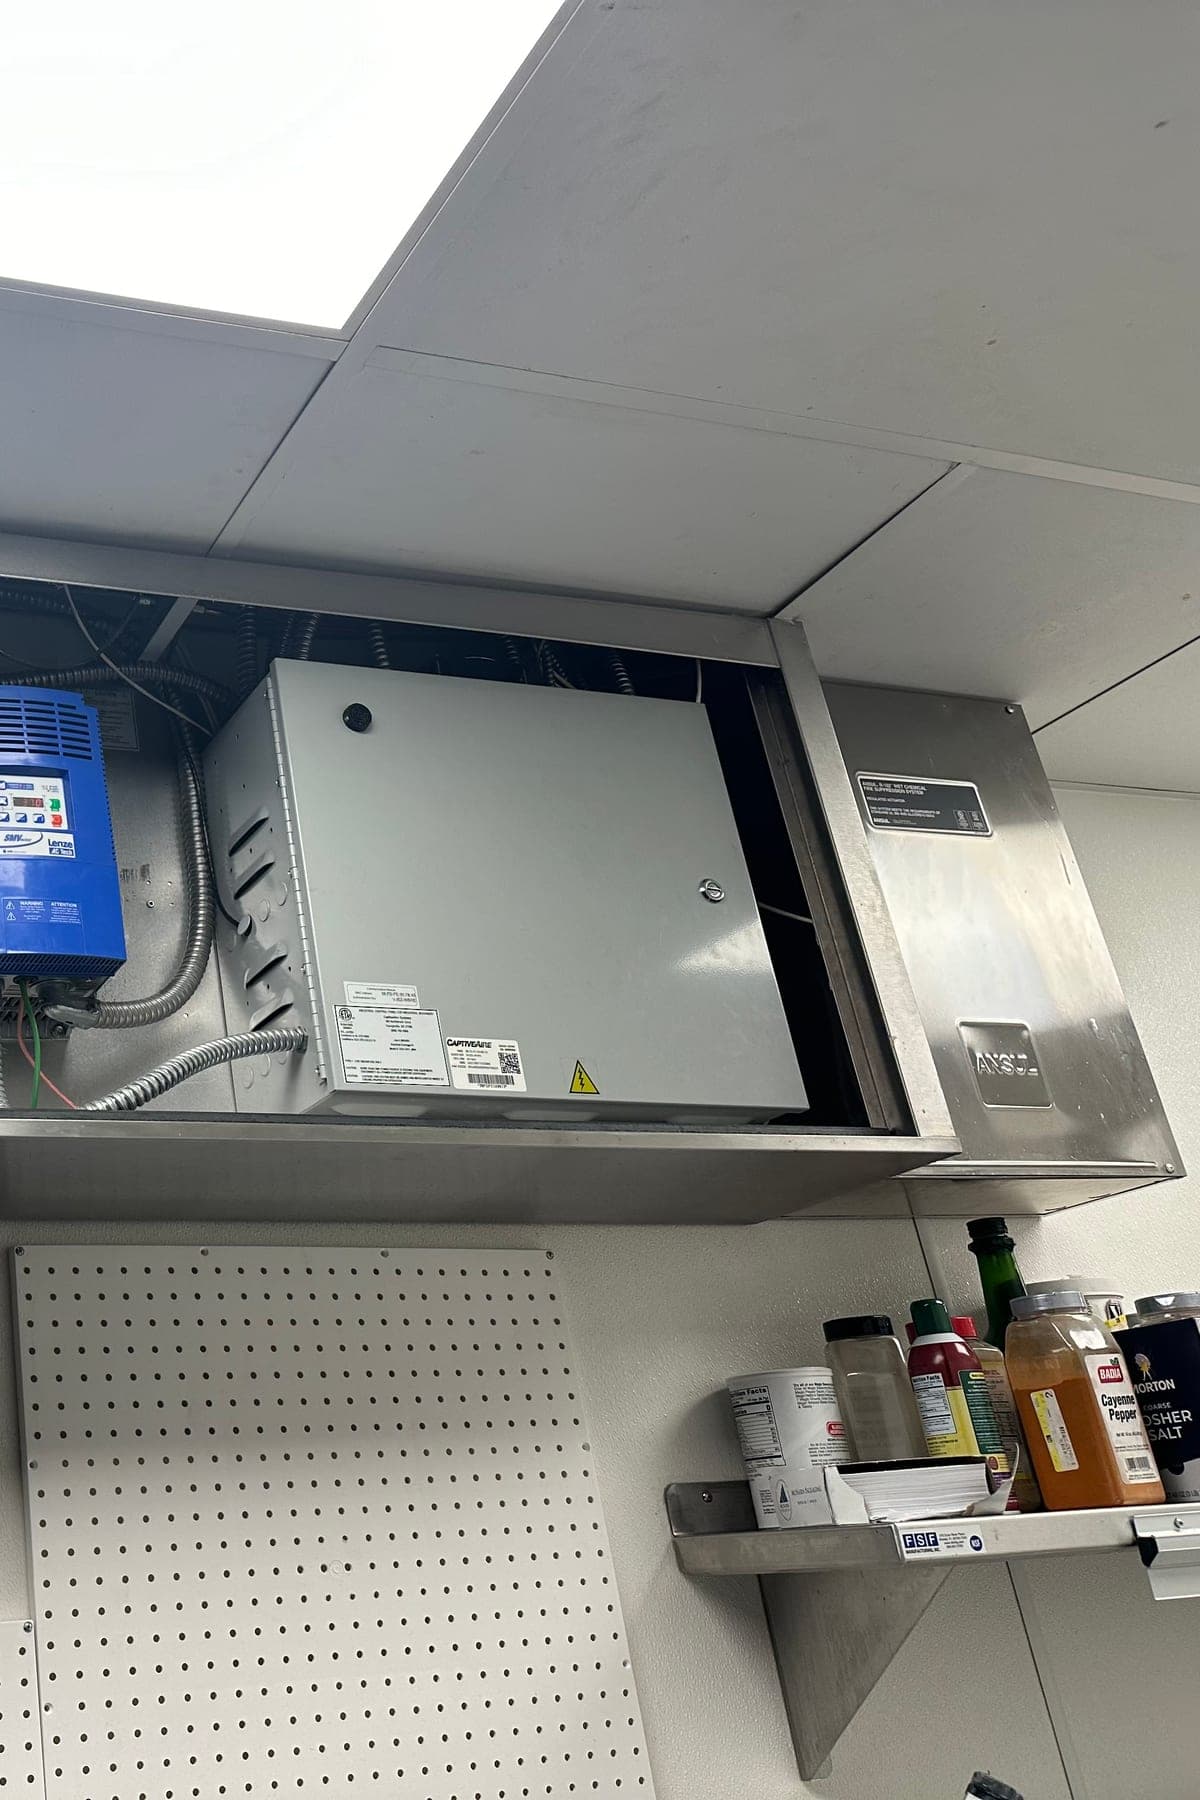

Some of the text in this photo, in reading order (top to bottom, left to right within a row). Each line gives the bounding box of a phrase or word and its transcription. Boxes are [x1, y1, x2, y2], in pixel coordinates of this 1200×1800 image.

[48, 838, 73, 849] Lenze
[447, 1039, 492, 1049] CAPTIVEAIRE
[1100, 1368, 1122, 1380] BADIA
[1101, 1394, 1136, 1408] Cayenne
[1109, 1408, 1138, 1423] Pepper
[1143, 1409, 1193, 1427] OSHER
[1148, 1426, 1183, 1441] SALT
[904, 1533, 937, 1547] FSF
